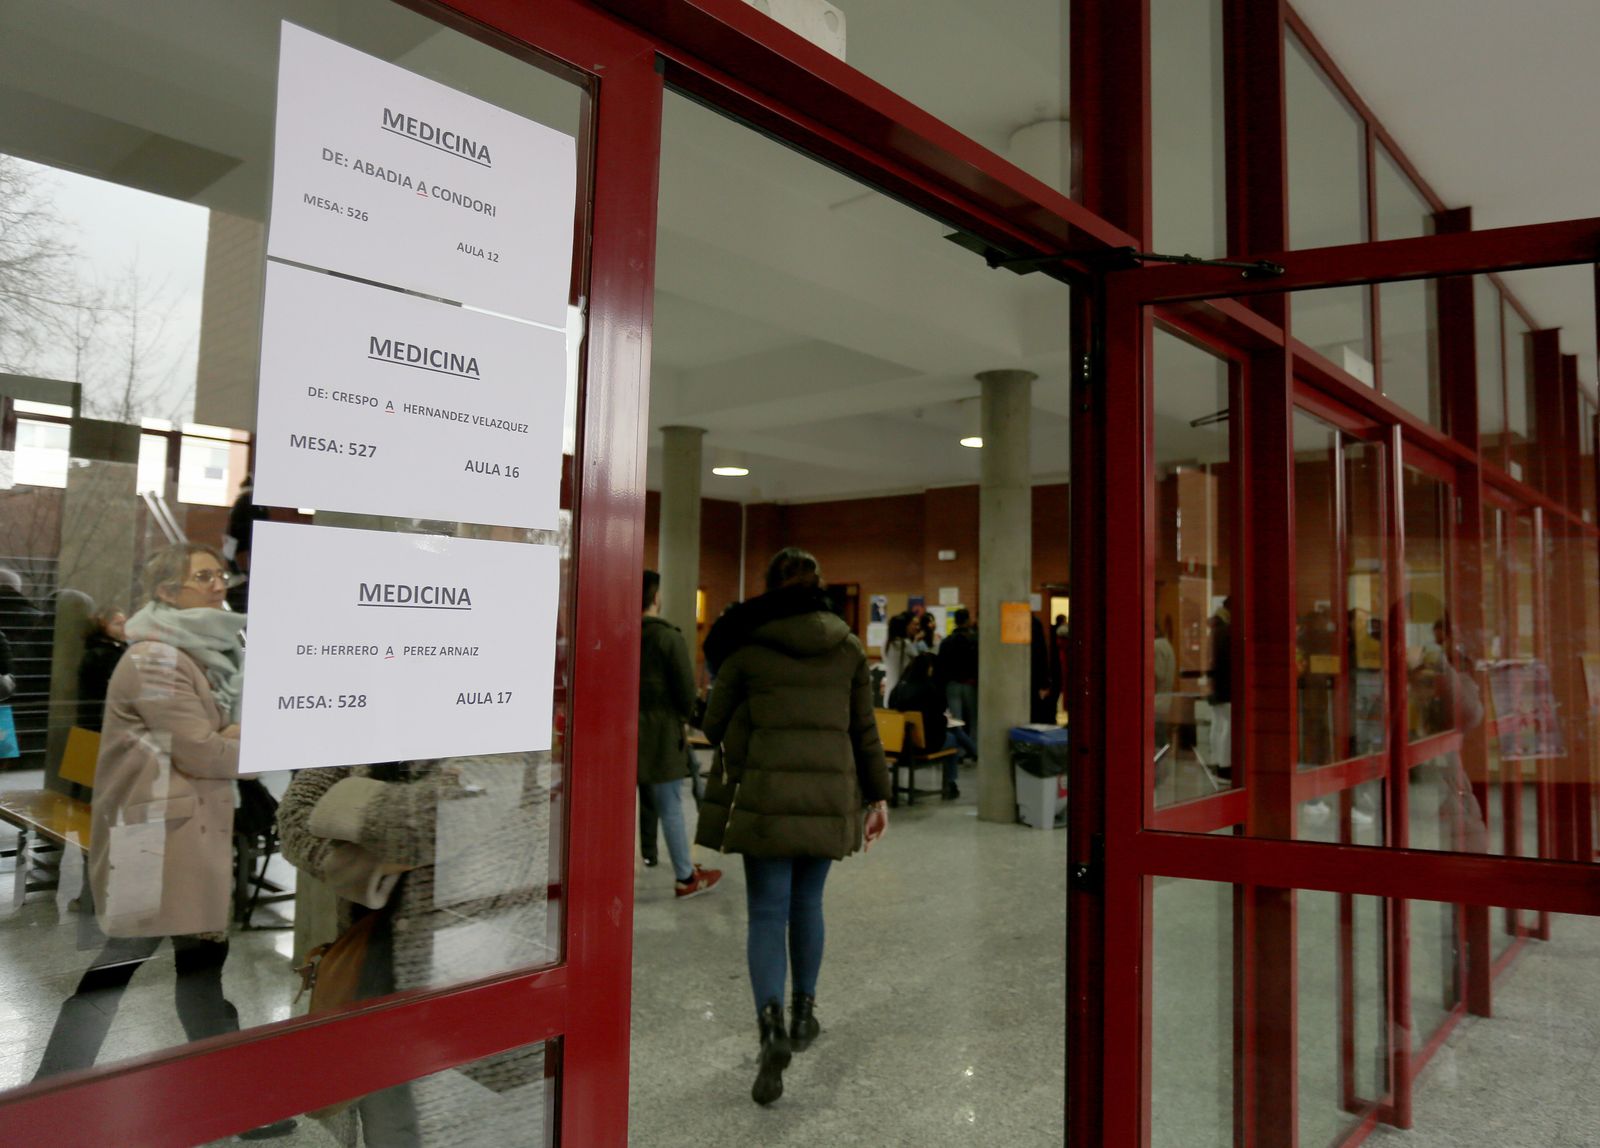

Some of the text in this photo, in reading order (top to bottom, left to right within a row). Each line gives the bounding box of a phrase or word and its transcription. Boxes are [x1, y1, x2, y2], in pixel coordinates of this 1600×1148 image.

[381, 107, 492, 168] MEDICINA
[322, 147, 497, 218] DE: ABADIA A CONDORI
[303, 193, 369, 222] MESA: 526
[456, 242, 499, 263] AULA 12
[368, 336, 481, 380] MEDICINA
[307, 386, 529, 434] DE: CRESPO A HERNANDEZ VELAZQUEZ
[290, 434, 377, 458] MESA: 527
[464, 460, 520, 479] AULA 16
[357, 583, 472, 610] MEDICINA
[296, 644, 479, 657] DE: HERRERO A PEREZ ARNAIZ
[278, 694, 367, 710] MESA: 528
[456, 692, 513, 705] AULA 17
